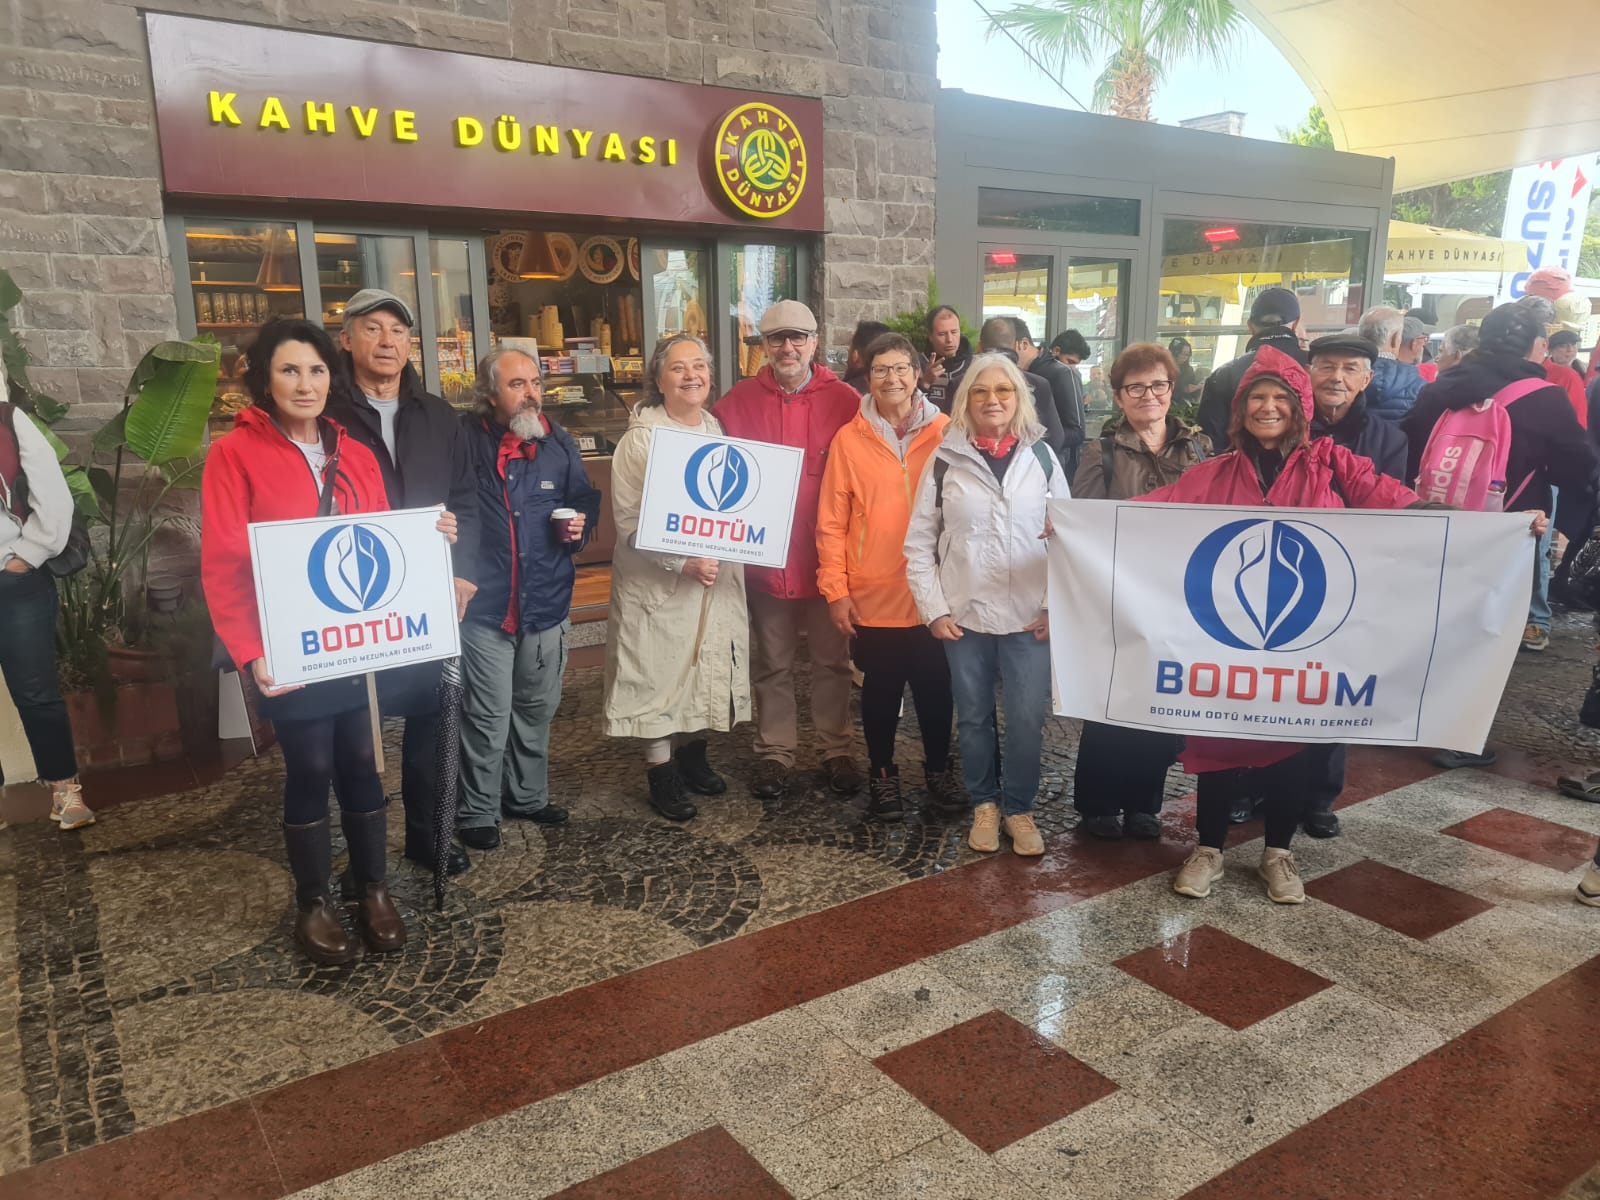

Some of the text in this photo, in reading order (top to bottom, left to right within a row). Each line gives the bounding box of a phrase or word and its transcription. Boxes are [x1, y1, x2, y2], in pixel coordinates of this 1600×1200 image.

[208, 90, 677, 165] KAHVE DÜNYASI
[725, 110, 799, 150] KAHVE
[726, 167, 800, 209] DÜNYASI
[1387, 247, 1501, 262] KAHVE DÜNYASI
[1510, 179, 1556, 299] SUZU
[1428, 446, 1462, 504] didas
[666, 513, 766, 545] BODTÜM
[301, 611, 429, 656] BODTÜM
[1156, 660, 1378, 706] BODTÜM
[1150, 706, 1201, 718] BODRUM
[1205, 710, 1239, 721] ODTÜ
[1243, 714, 1316, 726] MEZUNLARI
